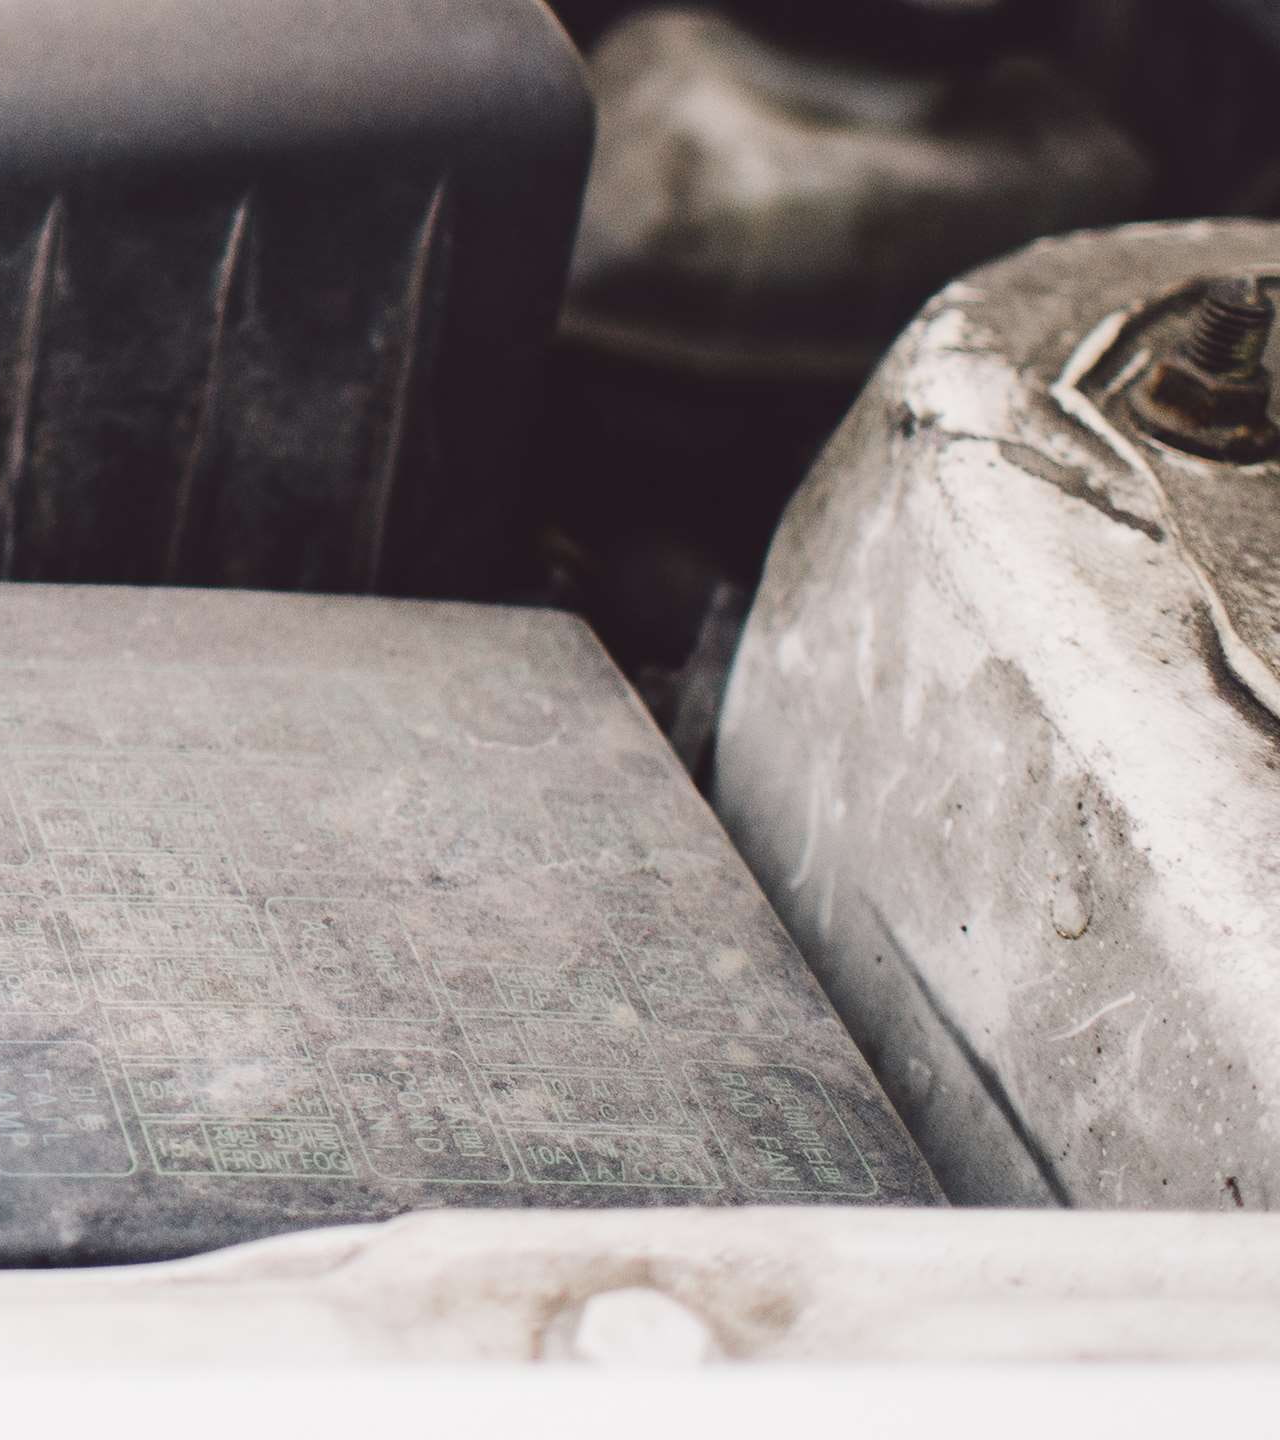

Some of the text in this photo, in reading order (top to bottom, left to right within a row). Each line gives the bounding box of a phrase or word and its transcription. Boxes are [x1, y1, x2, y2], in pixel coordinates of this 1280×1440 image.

[22, 1069, 71, 1145] TAIL
[386, 1071, 446, 1153] COND
[715, 1072, 766, 1118] RAD
[749, 1136, 800, 1182] FAN
[217, 1151, 351, 1171] FRONT FOG
[524, 1145, 574, 1165] 10A
